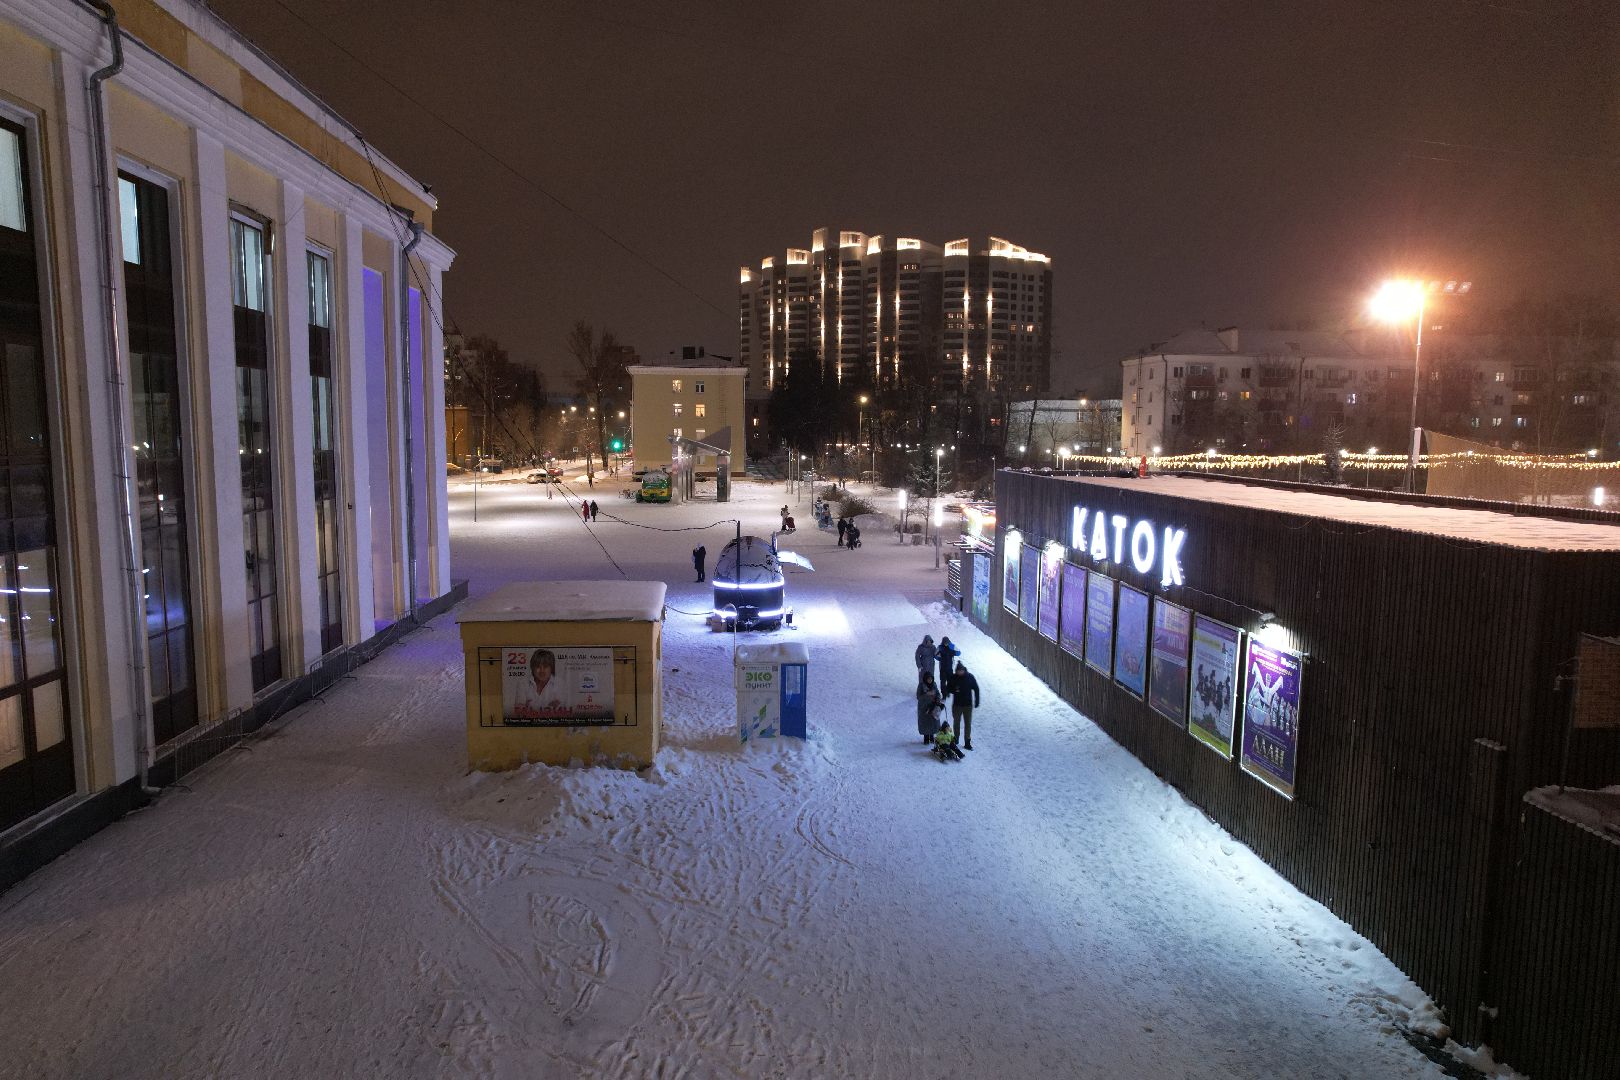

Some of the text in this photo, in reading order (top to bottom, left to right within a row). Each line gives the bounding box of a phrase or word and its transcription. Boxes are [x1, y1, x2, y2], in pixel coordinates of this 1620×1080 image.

[1071, 506, 1186, 587] КАТОК
[507, 653, 526, 664] 23
[745, 671, 772, 682] ЭКО
